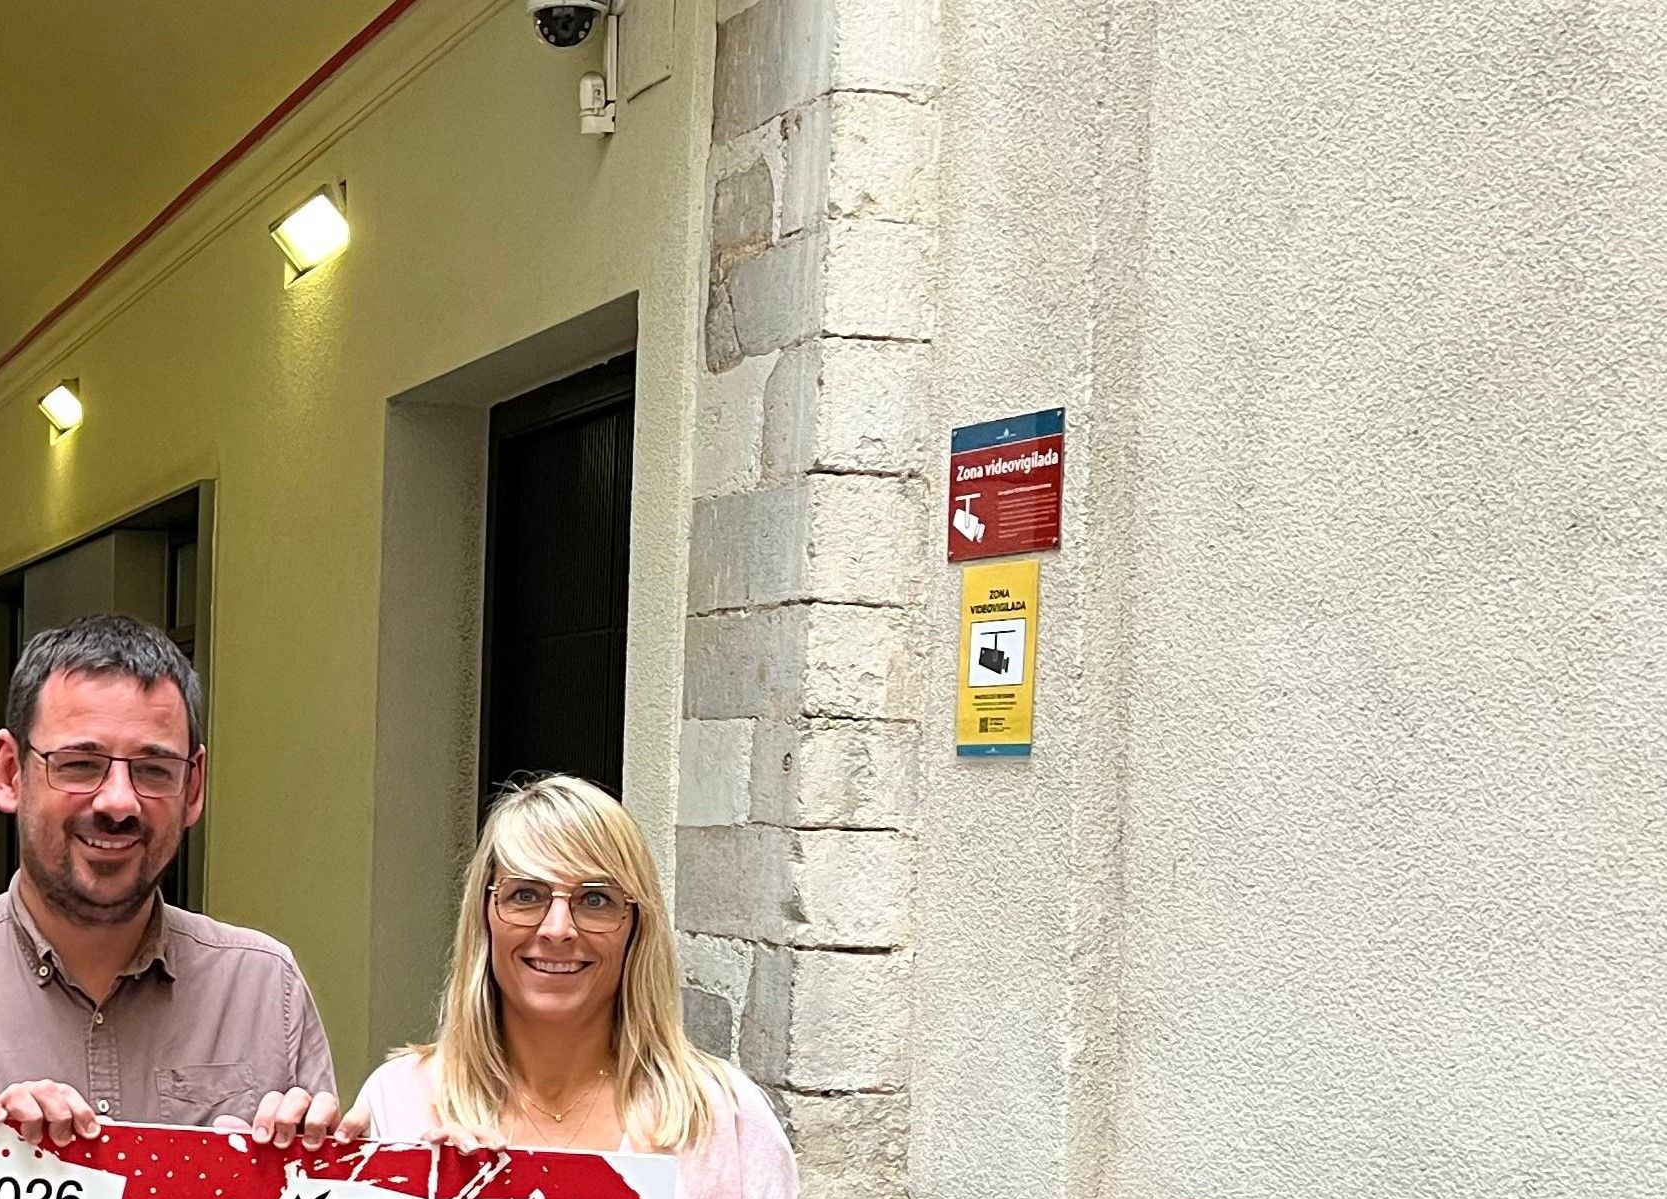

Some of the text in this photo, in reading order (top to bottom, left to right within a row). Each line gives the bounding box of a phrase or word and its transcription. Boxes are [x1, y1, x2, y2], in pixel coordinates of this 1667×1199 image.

[956, 448, 1059, 482] Zona videovigilada
[988, 589, 1010, 600] ZONA
